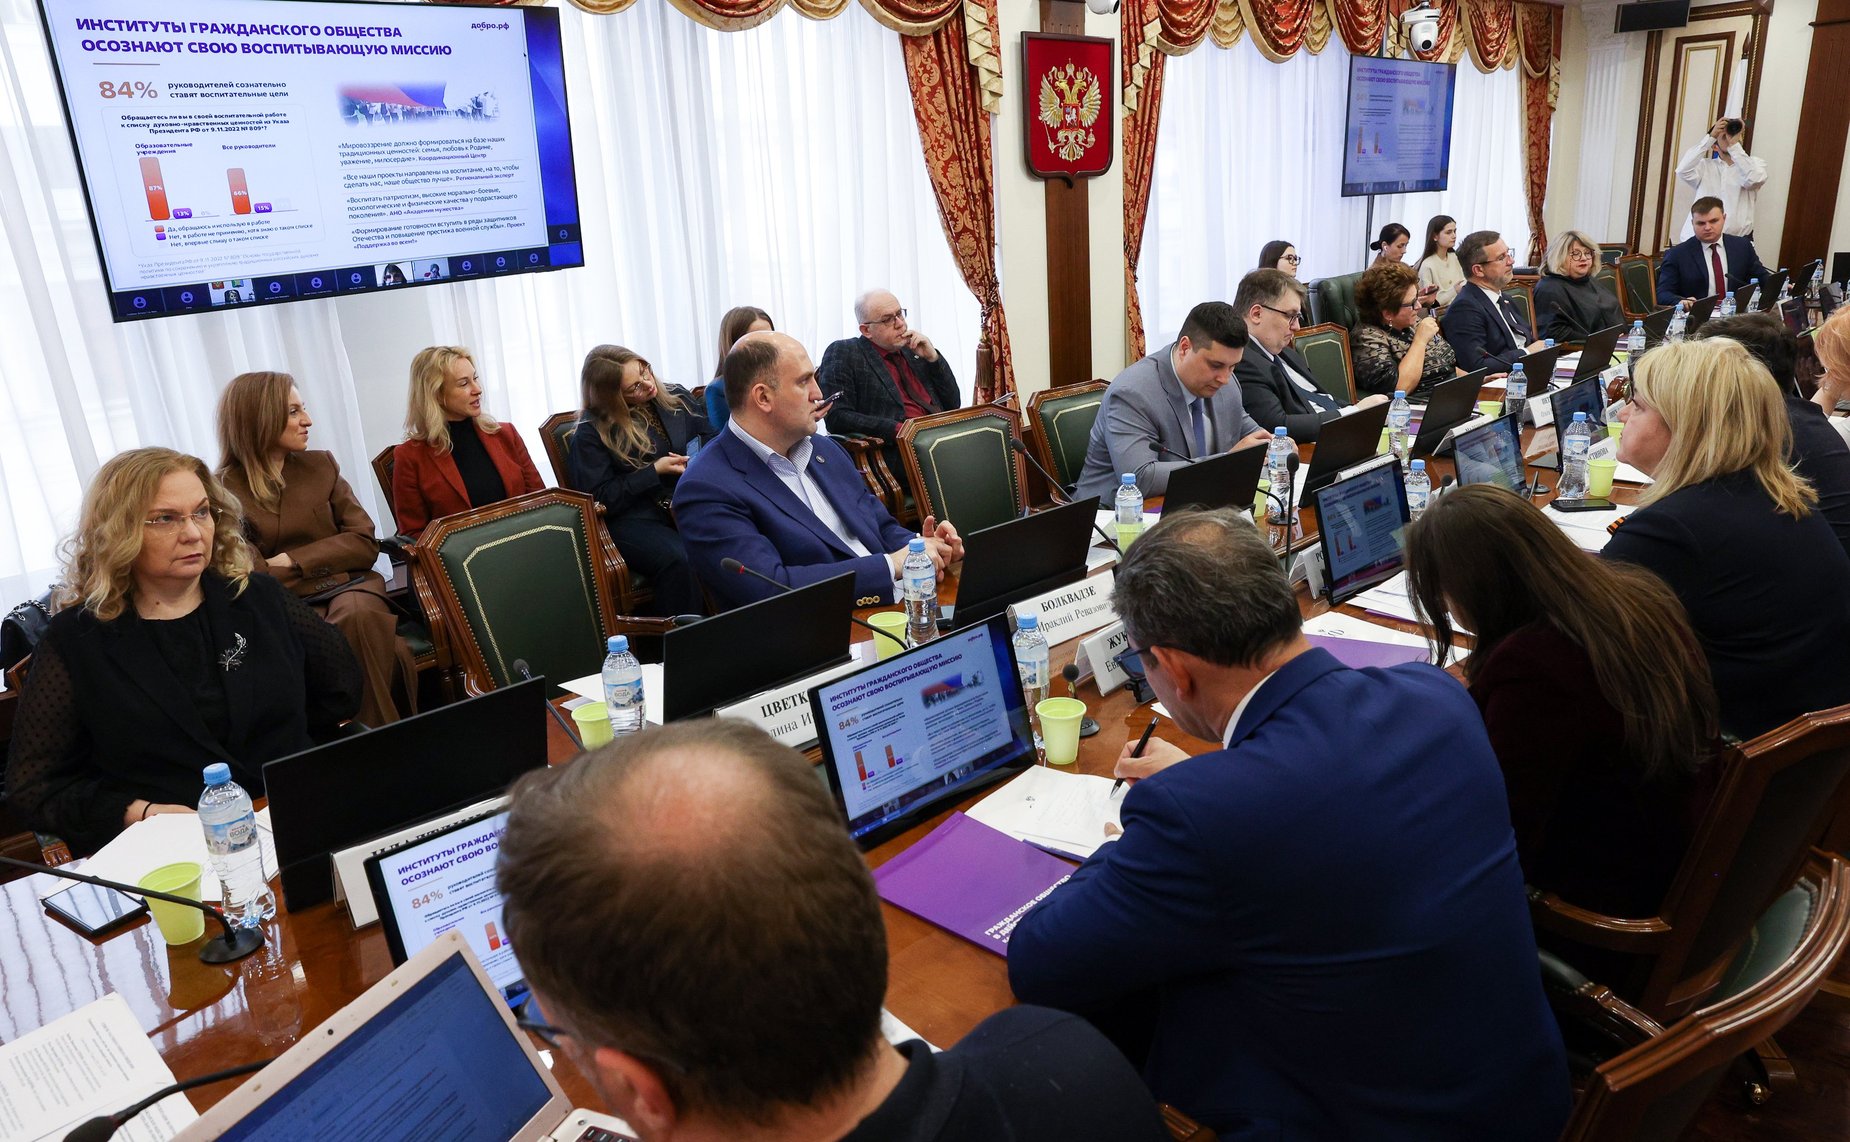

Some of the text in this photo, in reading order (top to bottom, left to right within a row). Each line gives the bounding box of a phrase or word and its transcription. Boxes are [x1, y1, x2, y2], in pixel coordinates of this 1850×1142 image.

[76, 18, 402, 38] ИНСТИТУТЫ ГРАЖДАНСКОГО ОБЩЕСТВА
[471, 22, 510, 30] добро.рф
[81, 39, 452, 56] ОСОЗНАЮТ СВОЮ ВОСПИТЫВАЮЩУЮ МИССИЮ
[98, 80, 158, 99] 84%
[348, 203, 400, 212] психологические
[426, 228, 454, 236] престижа
[1041, 586, 1096, 613] БОЛКВАДЗЕ
[1038, 612, 1074, 632] Ираклий
[830, 653, 942, 702] ИНСТИТУТЫ ГРАЖДАНСКОГО ОБЩЕСТВА
[832, 694, 865, 711] ОСОЗНАЮТ
[866, 686, 884, 697] СВОЮ
[884, 664, 938, 690] ВОСПИТЫВАЮЩУЮ
[938, 654, 962, 667] МИССИЮ
[761, 690, 809, 718] ЦВЕТК
[839, 716, 859, 730] 84%
[398, 848, 455, 875] ИНСТИТУТЫ
[401, 859, 454, 886] ОСОЗНАЮТ
[456, 849, 484, 864] СВОЮ
[412, 890, 443, 909] 84%
[984, 899, 1038, 936] ГРАЖДАНСКОЕ
